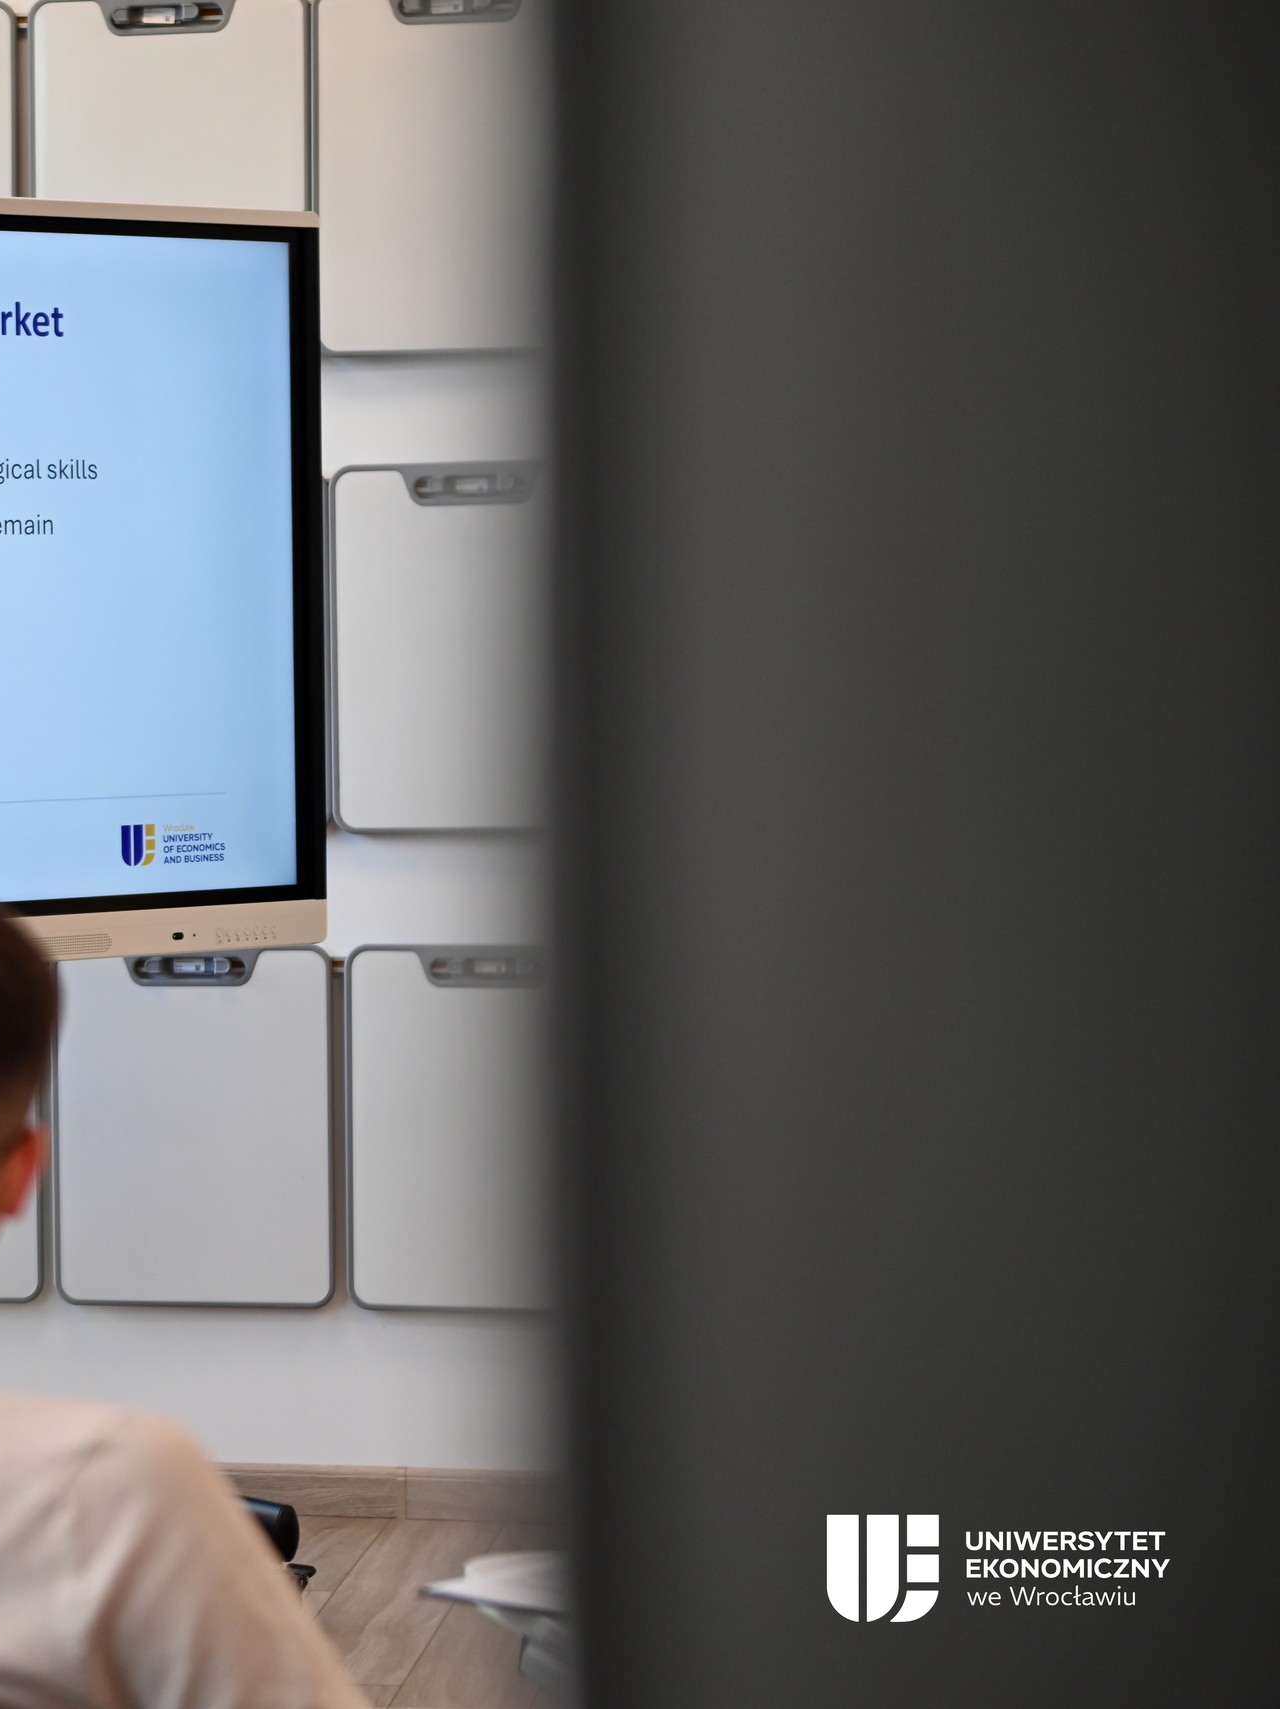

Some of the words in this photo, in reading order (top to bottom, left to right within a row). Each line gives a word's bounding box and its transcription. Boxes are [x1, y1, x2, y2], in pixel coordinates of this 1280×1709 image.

[47, 458, 98, 480] skills
[162, 833, 213, 843] UNIVERSITY
[163, 845, 174, 853] OF
[176, 843, 226, 853] ECONOMICS
[163, 855, 182, 864] AND
[184, 853, 225, 863] BUSINESS
